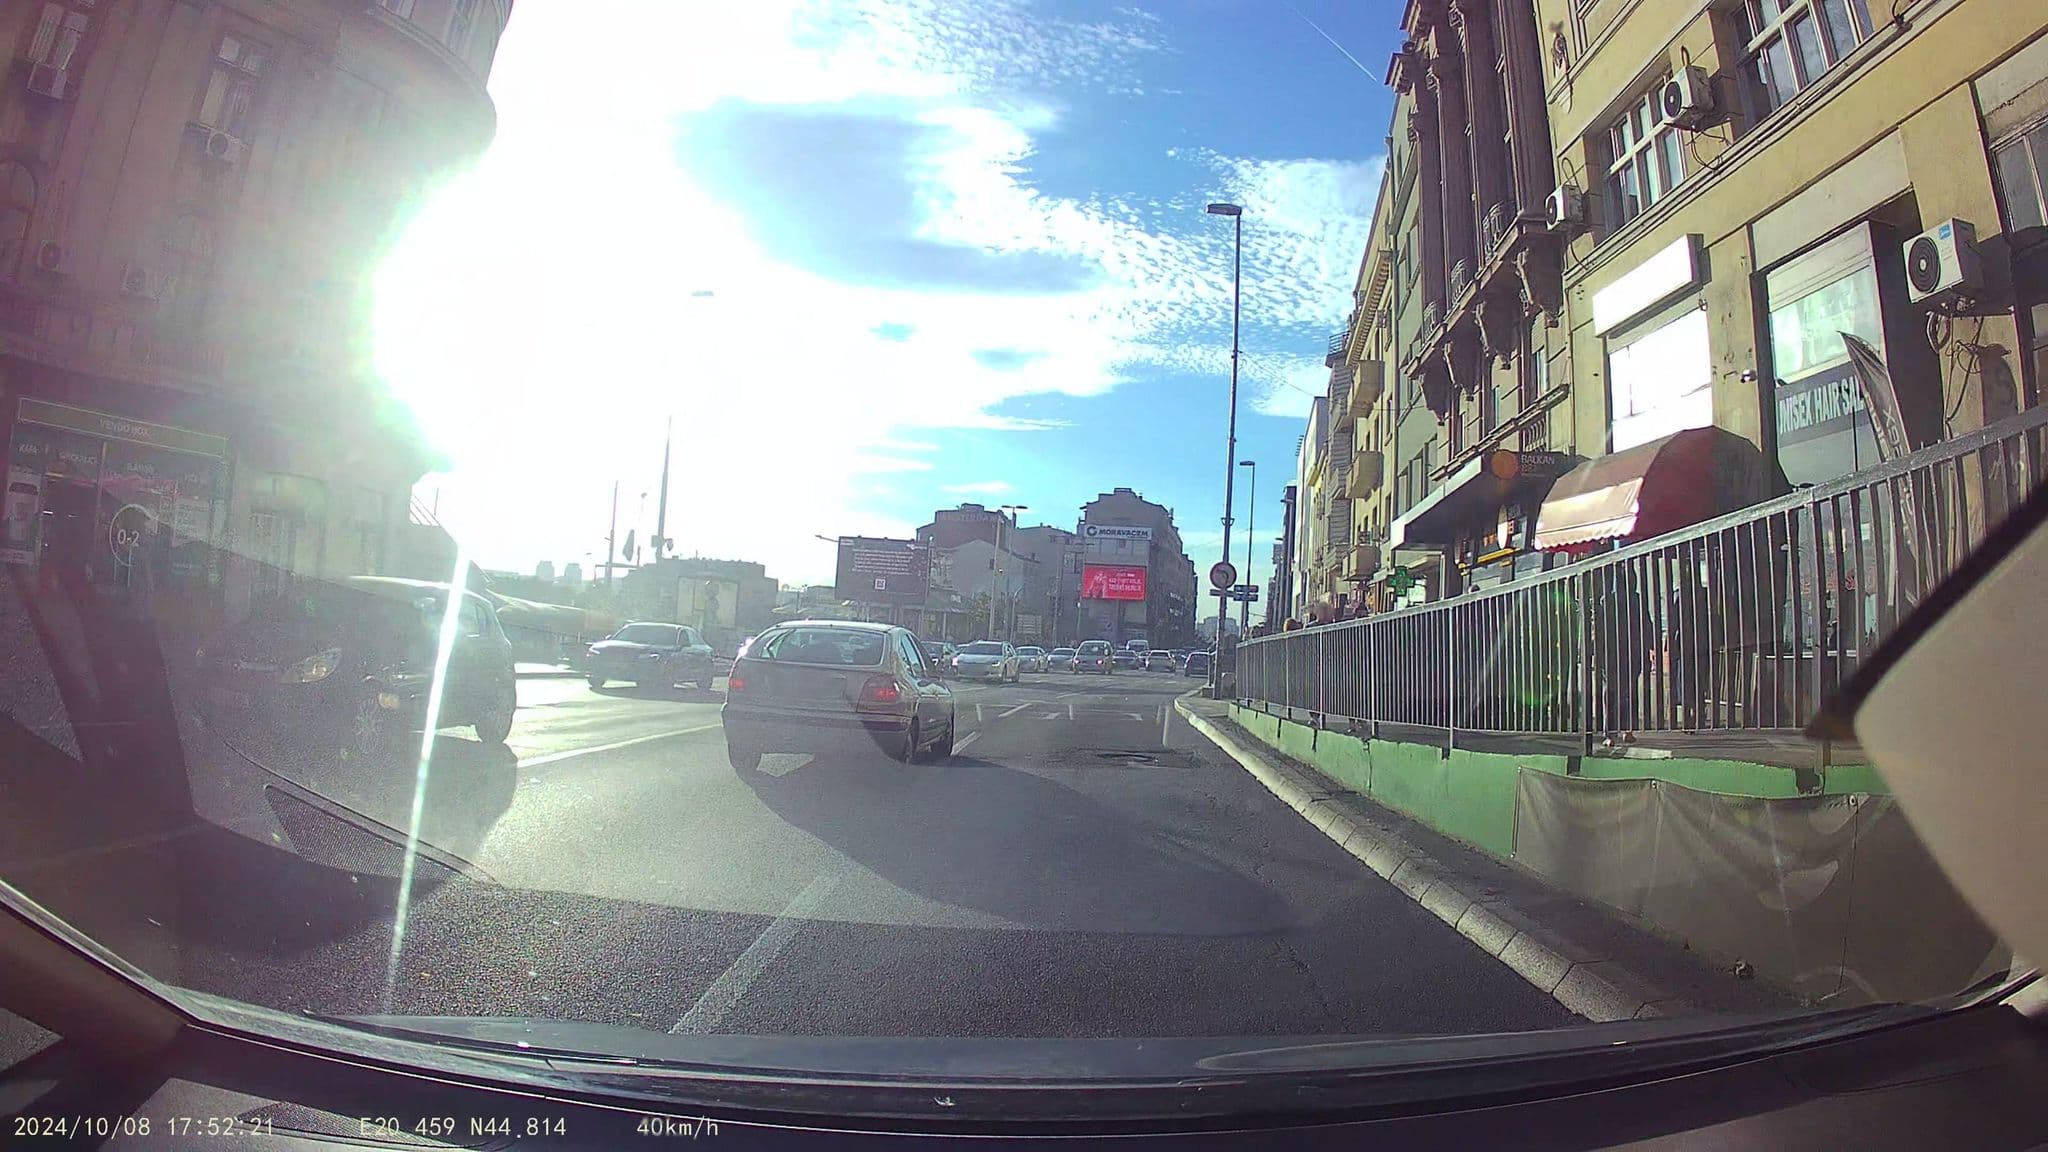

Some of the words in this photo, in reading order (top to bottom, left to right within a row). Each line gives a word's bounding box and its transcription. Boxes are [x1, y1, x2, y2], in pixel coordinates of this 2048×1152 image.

[1814, 382, 1841, 424] HAIR
[1841, 374, 1865, 416] SAL
[1521, 454, 1555, 465] BALKAN
[117, 528, 139, 548] 0-2
[1098, 528, 1149, 537] MORAVACEM
